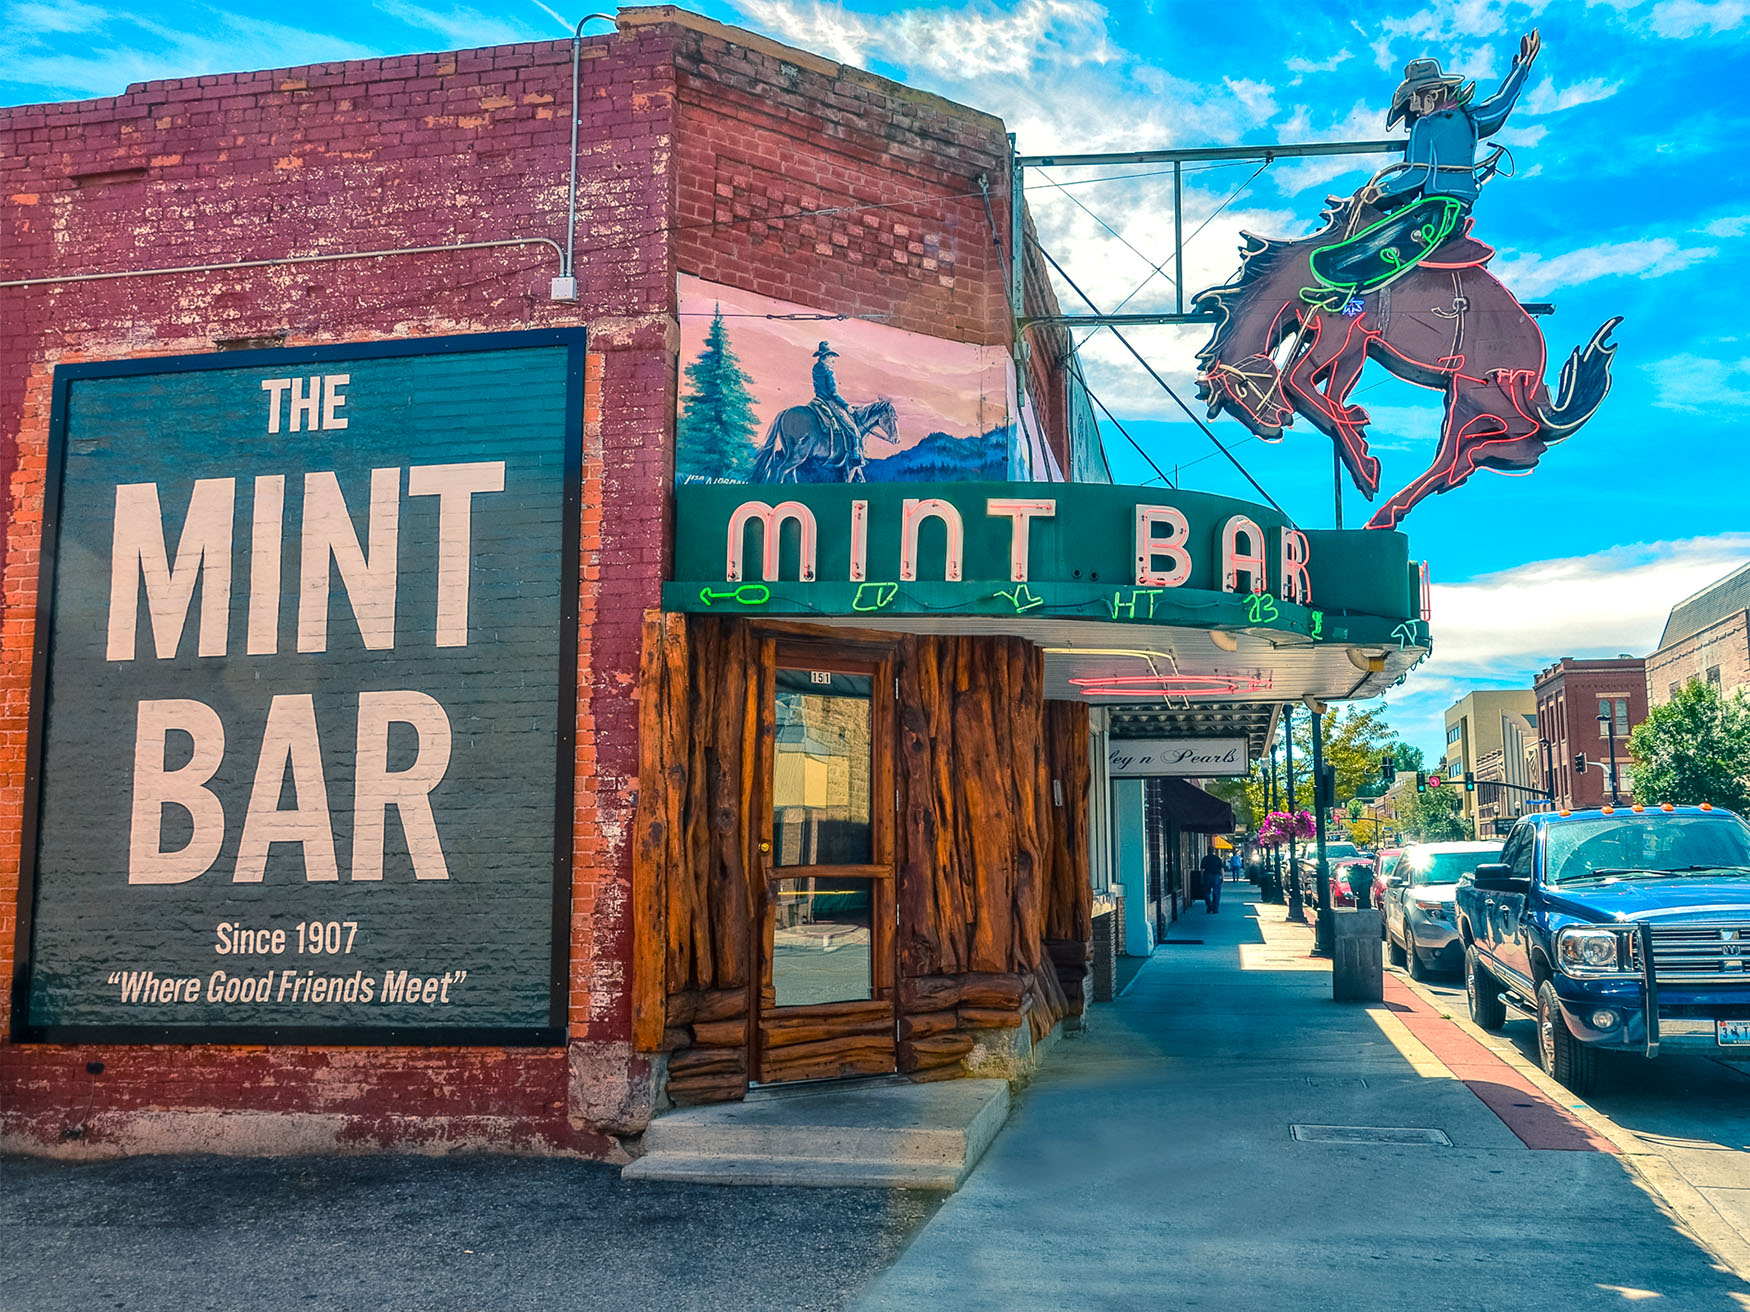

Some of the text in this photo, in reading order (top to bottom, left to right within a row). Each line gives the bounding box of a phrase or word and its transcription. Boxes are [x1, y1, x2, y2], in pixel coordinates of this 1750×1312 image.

[261, 374, 350, 433] THE
[106, 461, 505, 661] MINT
[726, 499, 1312, 606] MINT BAR
[812, 672, 830, 684] 151
[1160, 747, 1241, 765] Pearls
[128, 690, 453, 885] BAR
[215, 921, 358, 955] Since 1907
[107, 969, 468, 1003] “Where Good Friends Meet”
